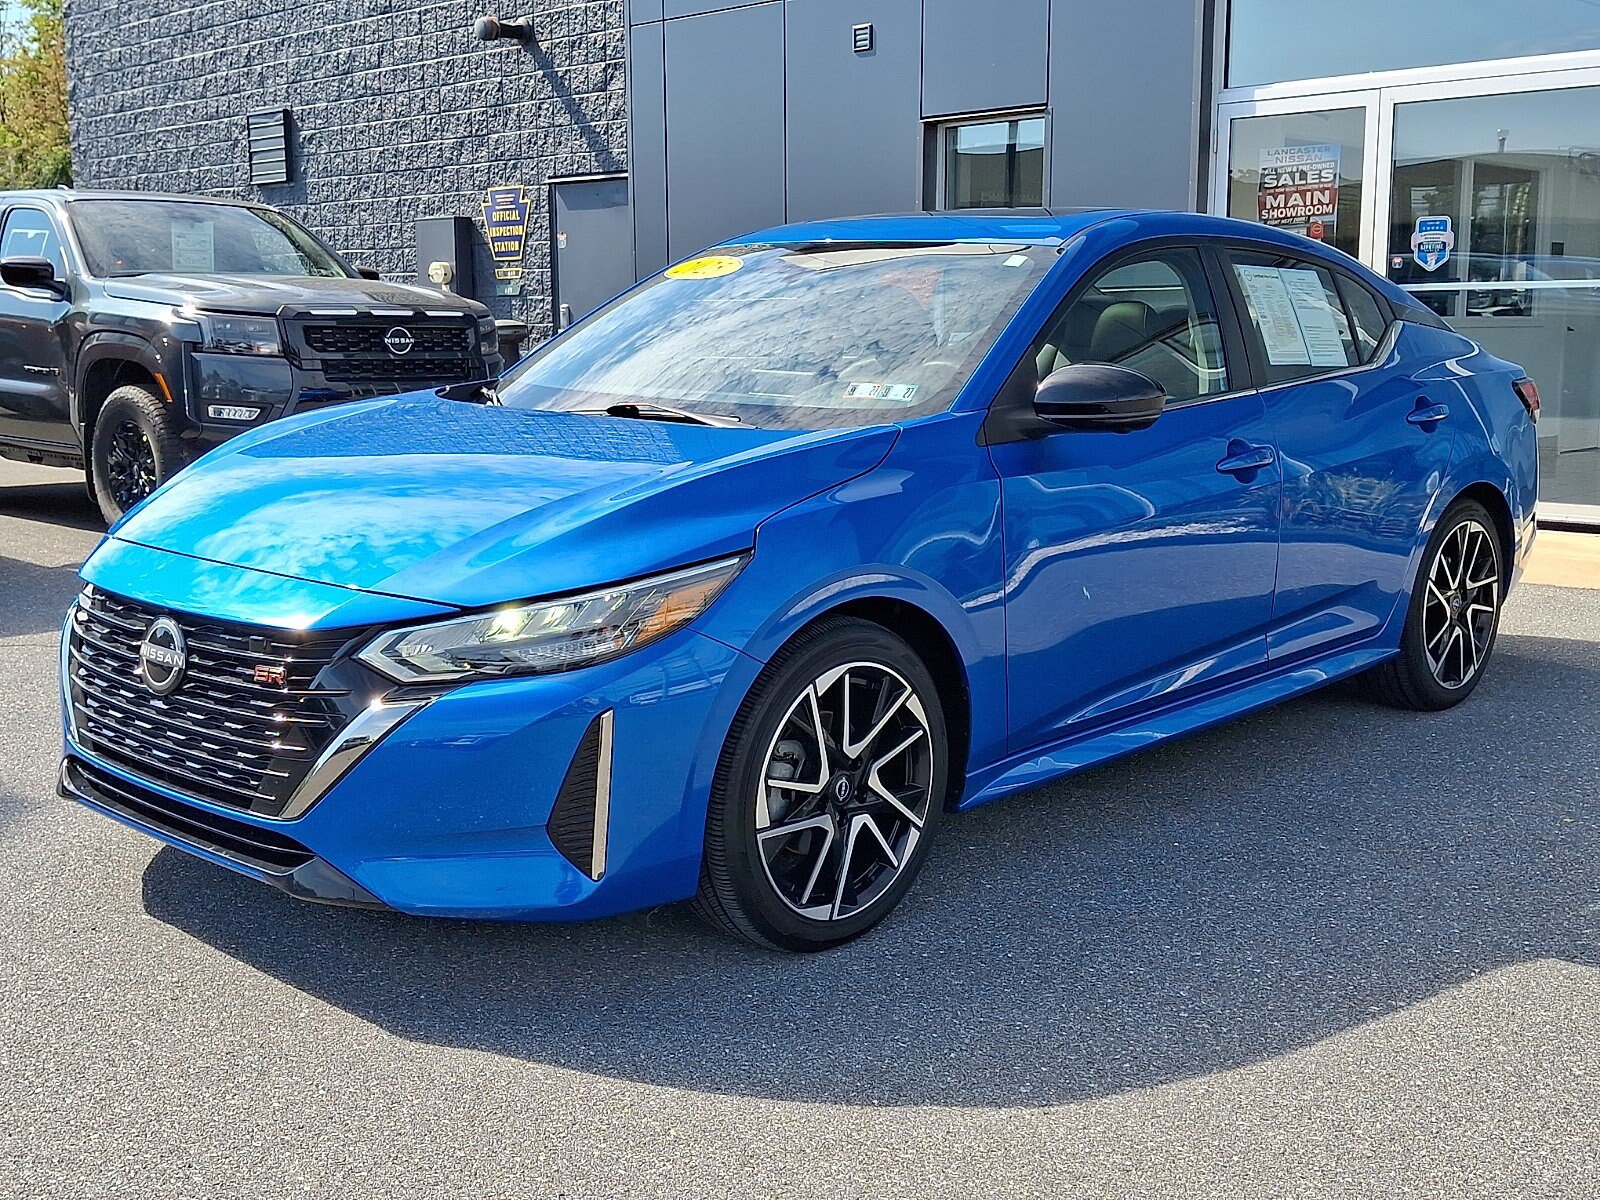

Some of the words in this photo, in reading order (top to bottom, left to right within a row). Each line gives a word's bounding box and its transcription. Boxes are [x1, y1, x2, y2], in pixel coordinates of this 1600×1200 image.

[1267, 146, 1330, 155] LANCASTER
[1275, 154, 1323, 163] NISSAN
[1278, 165, 1293, 174] NEW
[1263, 169, 1334, 188] SALES
[1265, 189, 1330, 209] MAIN
[492, 210, 520, 221] OFFICIAL
[1261, 204, 1333, 219] SHOWROOM
[490, 225, 523, 237] INSPECTION
[494, 240, 519, 252] STATION
[902, 387, 915, 398] 27
[140, 642, 185, 667] NISSAN
[254, 664, 287, 687] SR
